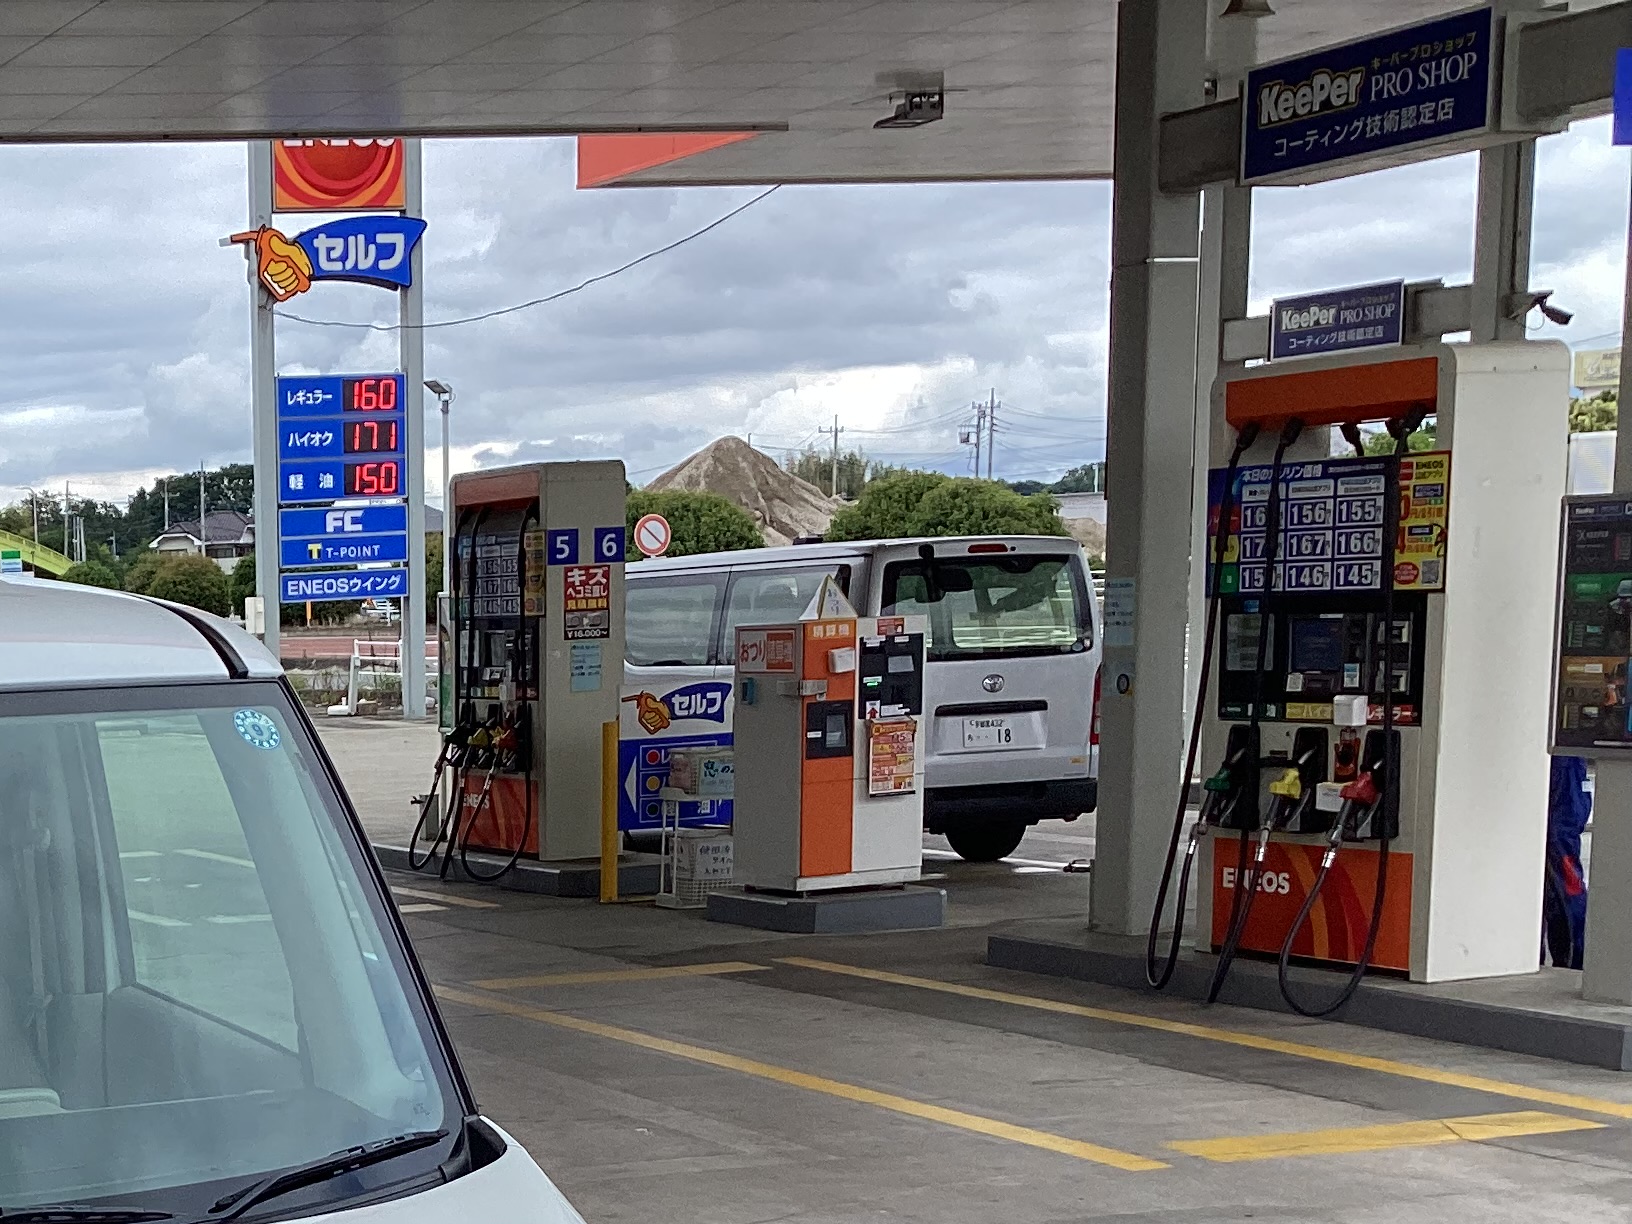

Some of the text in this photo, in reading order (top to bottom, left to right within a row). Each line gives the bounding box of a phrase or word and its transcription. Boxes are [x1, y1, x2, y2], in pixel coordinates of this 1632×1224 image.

[1260, 52, 1477, 124] KeePer PRO SHOP
[1274, 98, 1456, 157] コーティング技術認定店
[314, 231, 406, 271] セルフ
[1281, 303, 1396, 330] KeePer PRO SHOP
[287, 379, 396, 410] レギュラー 160
[288, 422, 397, 452] ハイオク 171
[355, 463, 397, 493] 150
[326, 510, 365, 532] FC
[1244, 505, 1268, 528] 16
[1291, 500, 1326, 525] 156
[1339, 498, 1376, 522] 155
[326, 543, 381, 559] T-POINT
[556, 533, 617, 559] 5 6
[1244, 536, 1267, 559] 17
[1290, 531, 1325, 556] 167
[1338, 529, 1374, 553] 166
[287, 575, 403, 596] ENEOSウイング
[567, 567, 609, 586] キズ
[1289, 564, 1324, 587] 146
[1337, 561, 1373, 585] 145
[671, 691, 723, 717] セルフ
